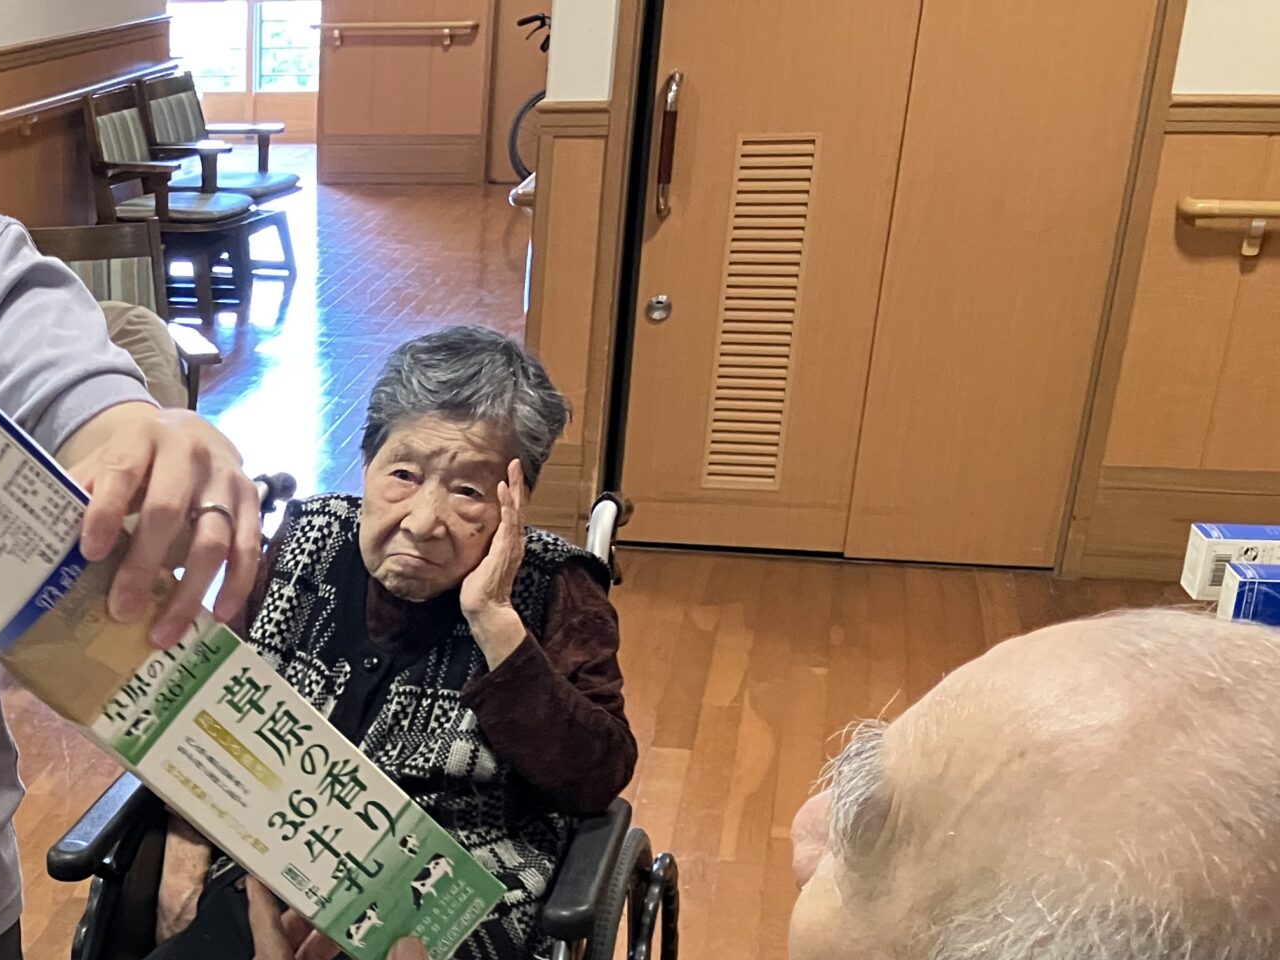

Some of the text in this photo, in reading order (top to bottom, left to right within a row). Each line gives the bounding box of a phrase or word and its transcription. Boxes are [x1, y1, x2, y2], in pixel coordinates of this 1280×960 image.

[216, 665, 398, 839] 草原の香り
